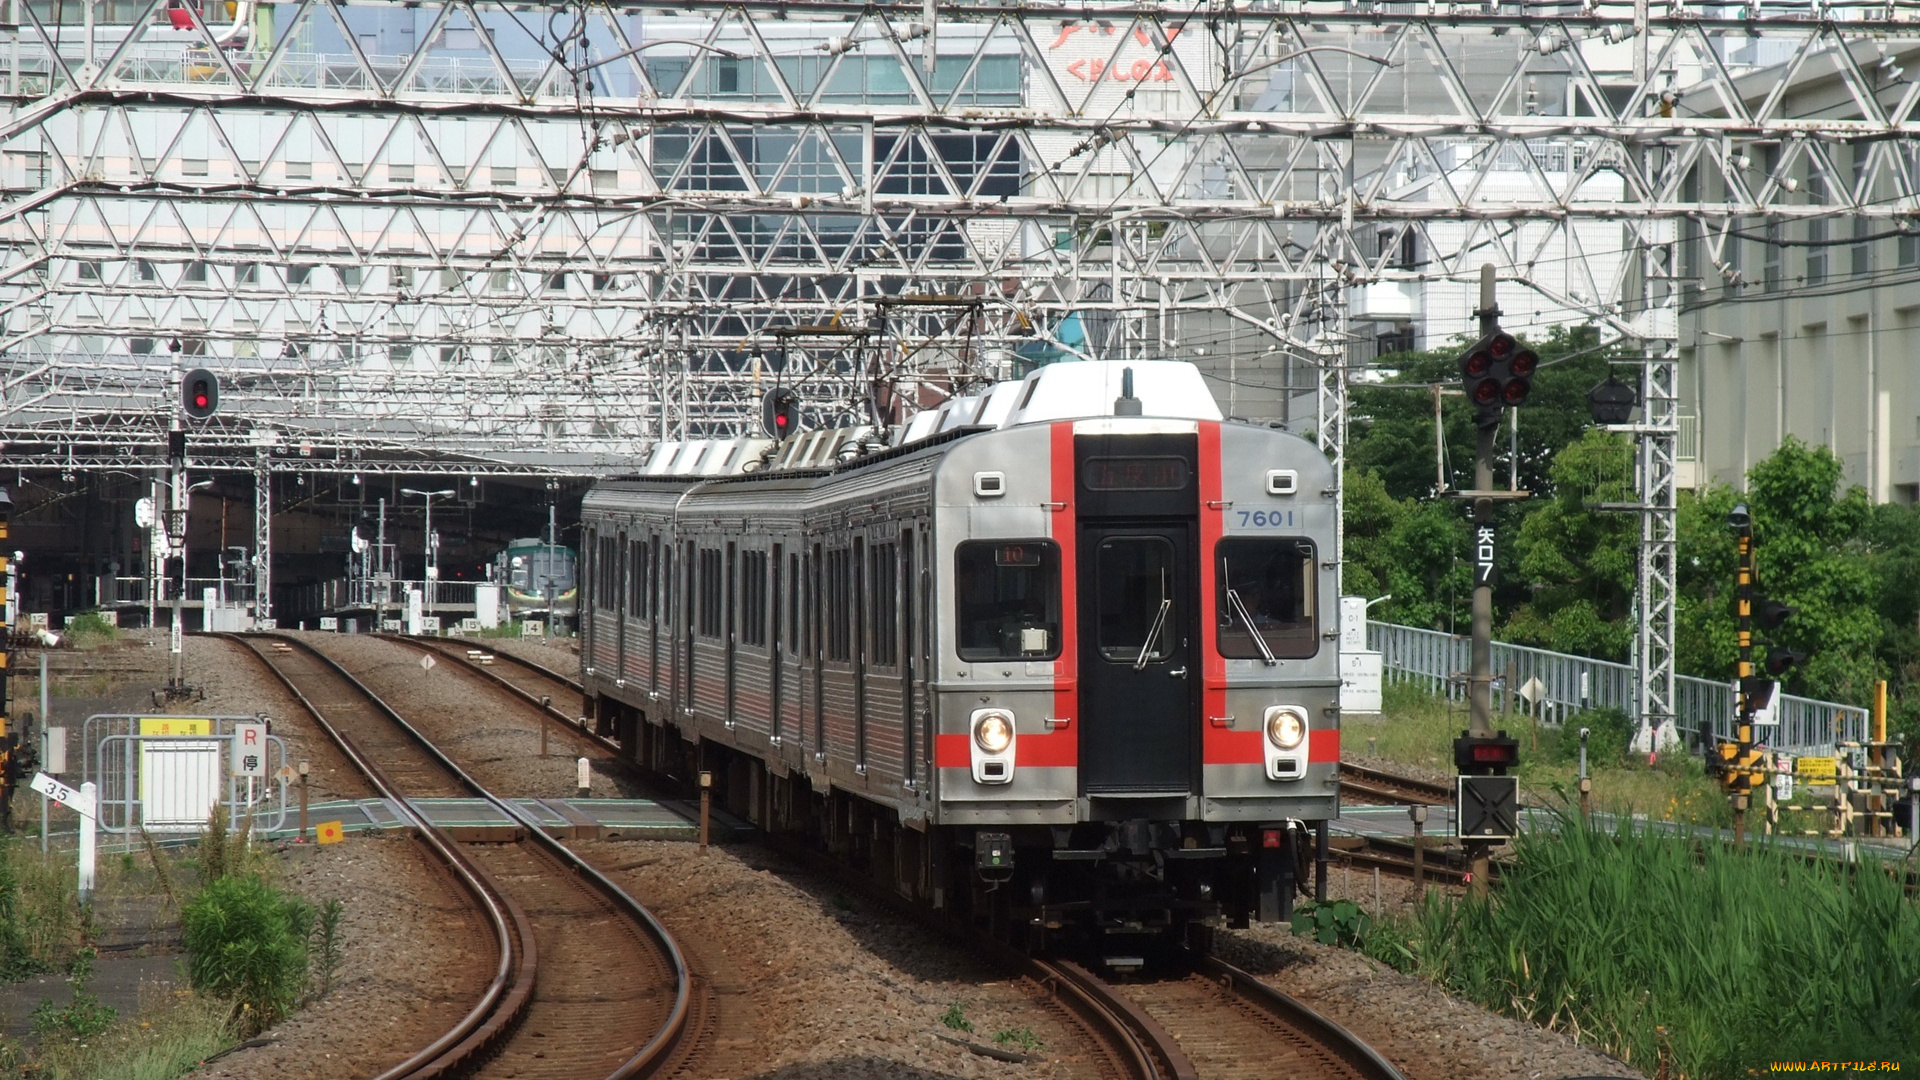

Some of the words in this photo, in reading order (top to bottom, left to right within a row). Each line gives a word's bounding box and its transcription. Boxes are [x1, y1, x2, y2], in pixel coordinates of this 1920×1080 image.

[1237, 510, 1293, 527] 7601
[1478, 525, 1495, 581] 矢口7
[244, 729, 257, 745] R
[242, 755, 258, 771] 停
[45, 782, 69, 801] 35
